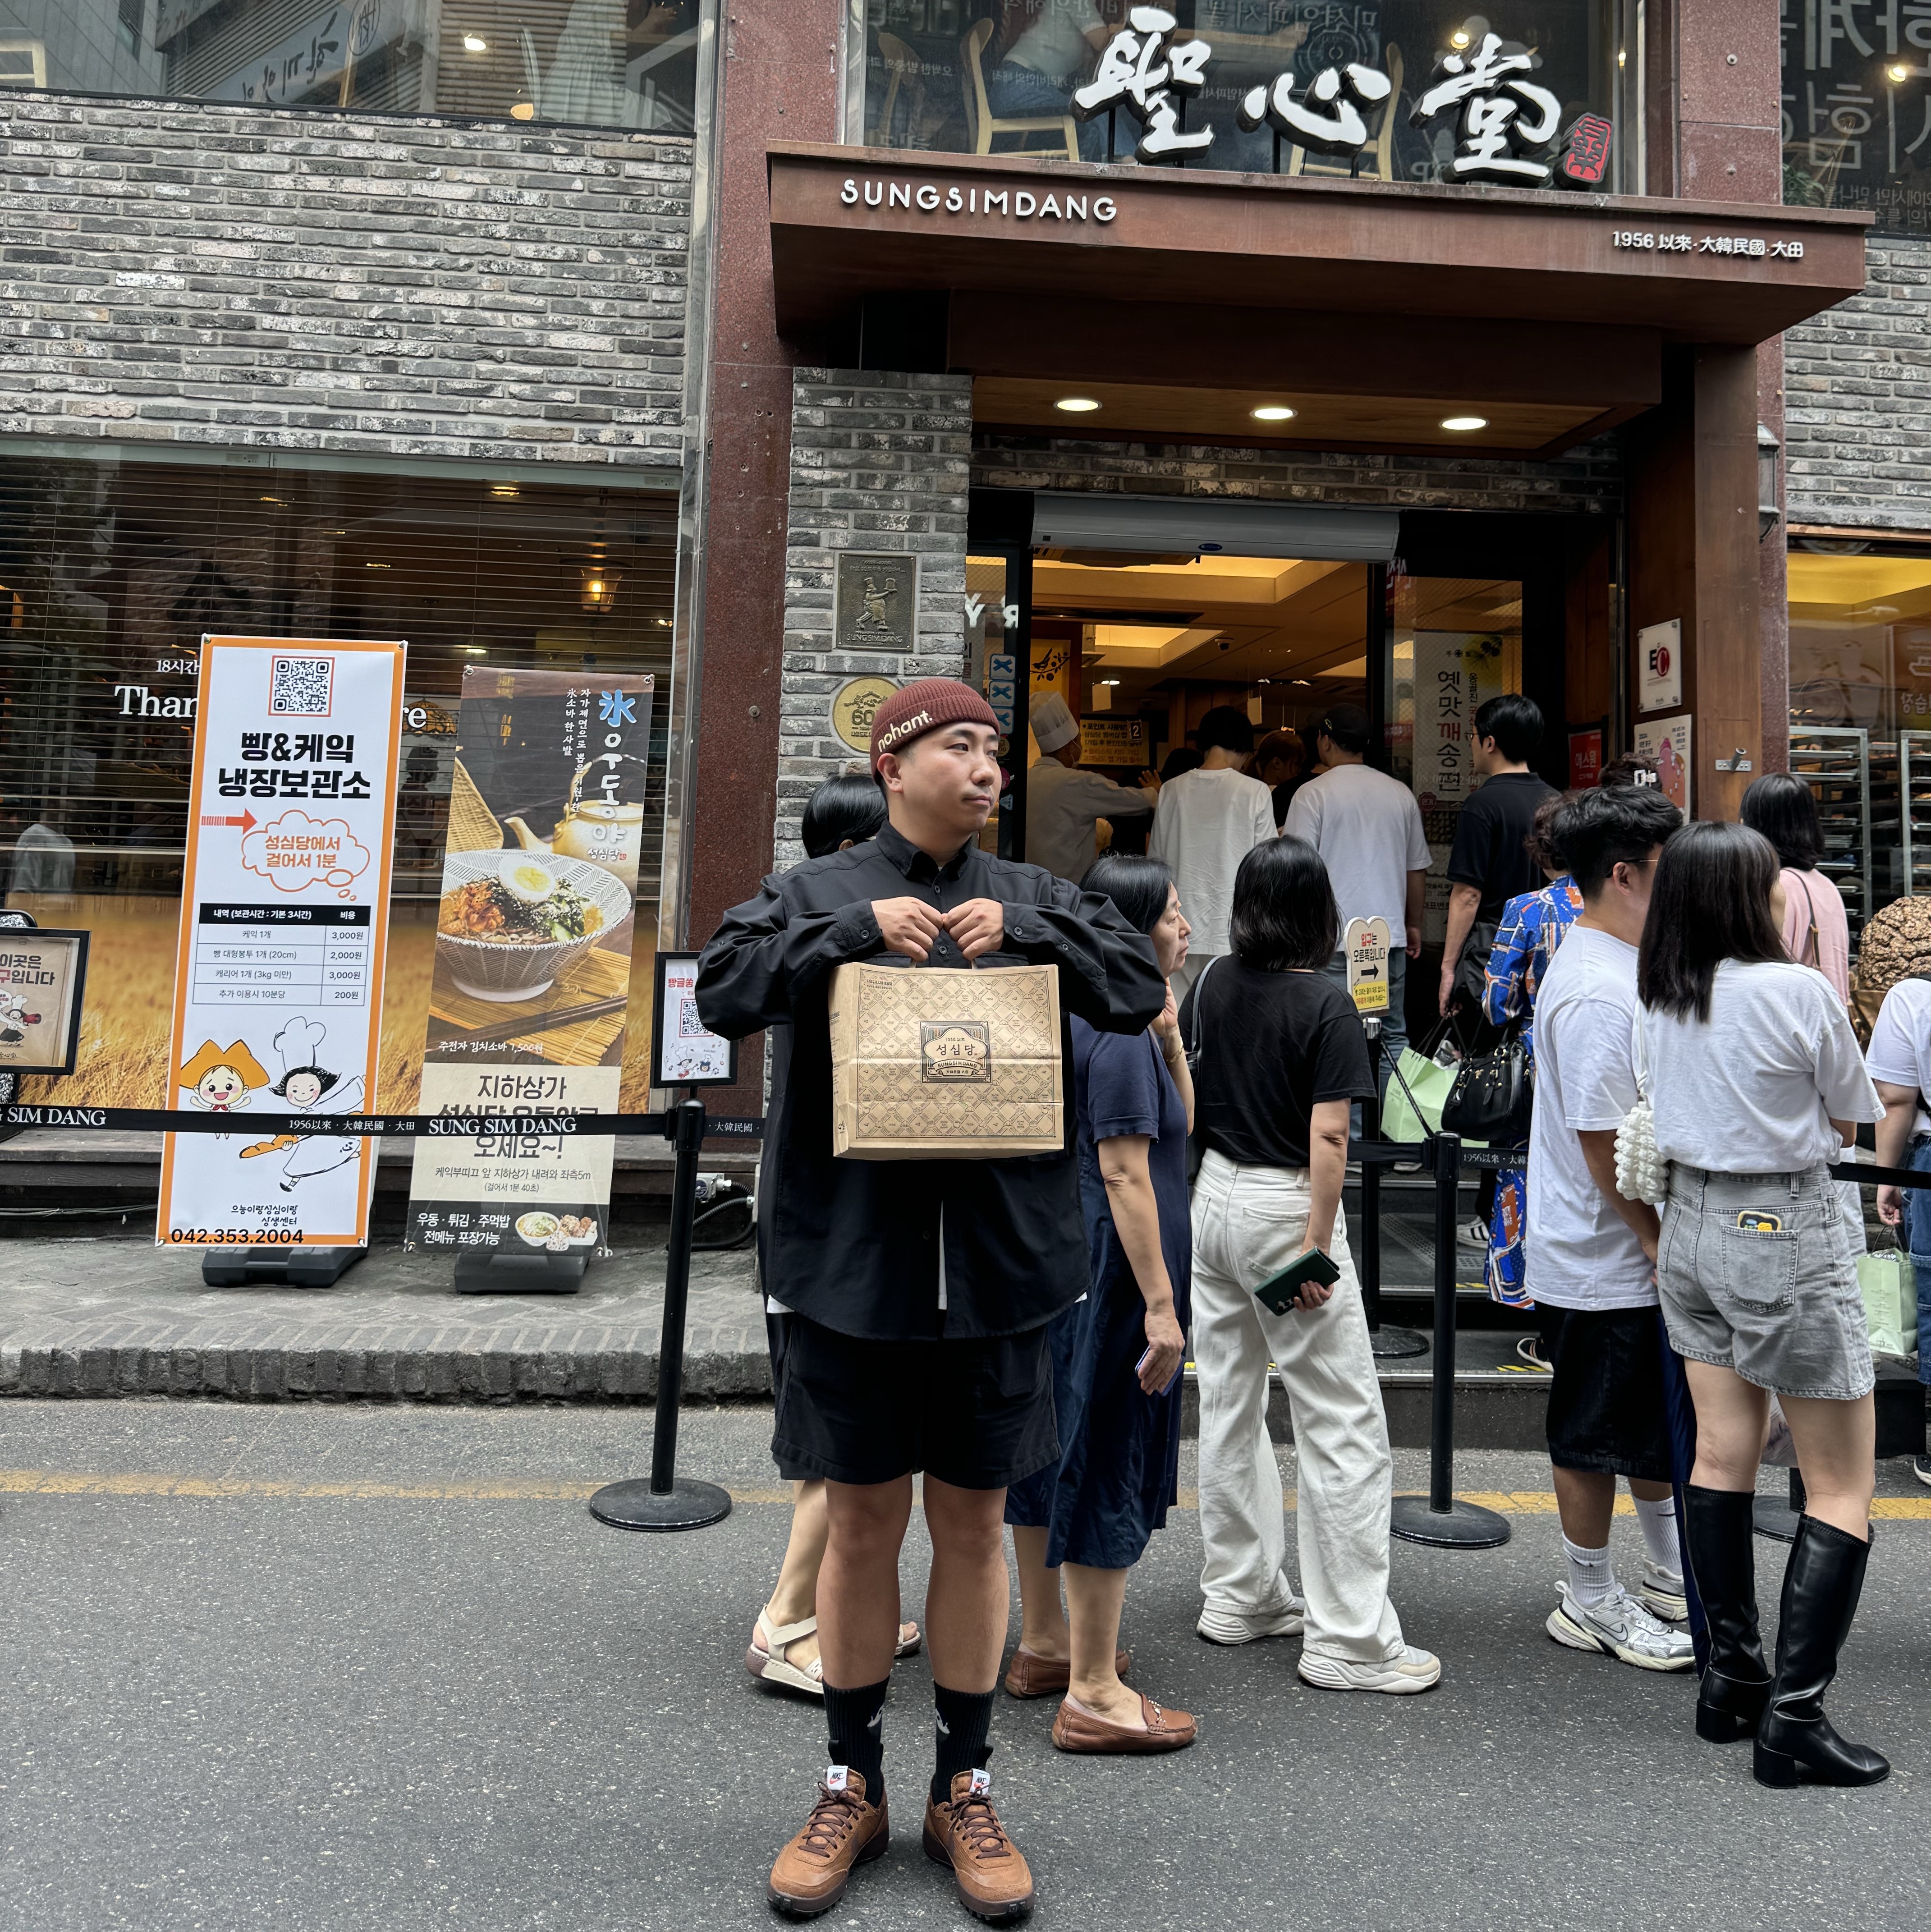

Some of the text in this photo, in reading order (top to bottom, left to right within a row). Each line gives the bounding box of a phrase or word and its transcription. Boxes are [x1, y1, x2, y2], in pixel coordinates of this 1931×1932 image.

[1073, 6, 1561, 177] 聖心堂
[840, 179, 1117, 221] SUNGSIMDANG
[1612, 231, 1654, 248] 1956
[564, 721, 575, 732] 한
[878, 710, 933, 752] nohant.
[1133, 725, 1139, 736] 2
[241, 732, 354, 762] 빵&케익
[563, 735, 574, 756] 사발
[219, 767, 370, 799] 냉장보관소
[265, 835, 340, 850] 성심당에서
[266, 853, 337, 868] 걸어서 1분
[587, 848, 619, 860] 성심당
[214, 909, 355, 921] 내역 (보관시간 기본 3시간) 비용
[243, 930, 364, 941] 케익 1개 3,000원
[0, 954, 41, 969] 이곳은
[213, 950, 362, 961] 빵 대형봉투 1개 (20cm) 2,000원
[216, 969, 361, 981] 캐리어 1개 (3kg 미만) 3,000원
[219, 989, 359, 1000] 추가 이용시 10분당 200원
[439, 1042, 467, 1051] 주전자
[470, 1042, 507, 1052] 김치소바
[936, 1044, 975, 1055] 성심당
[478, 1075, 566, 1099] 지하상가
[8, 1108, 42, 1124] SIM
[47, 1109, 106, 1126] DANG
[395, 1121, 415, 1131] 大田
[429, 1117, 577, 1134] SUNG SIM DANG
[482, 1168, 491, 1179] 앞
[495, 1168, 529, 1179] 지하상가
[532, 1168, 557, 1180] 내려와
[485, 1183, 539, 1193] (걸어서 1분 40초)
[261, 1217, 297, 1226] 상생센터
[417, 1213, 510, 1228] 우동 튀김 주먹밥
[171, 1229, 303, 1243] 042.353.2004
[424, 1231, 500, 1245] 전메뉴 포장가능
